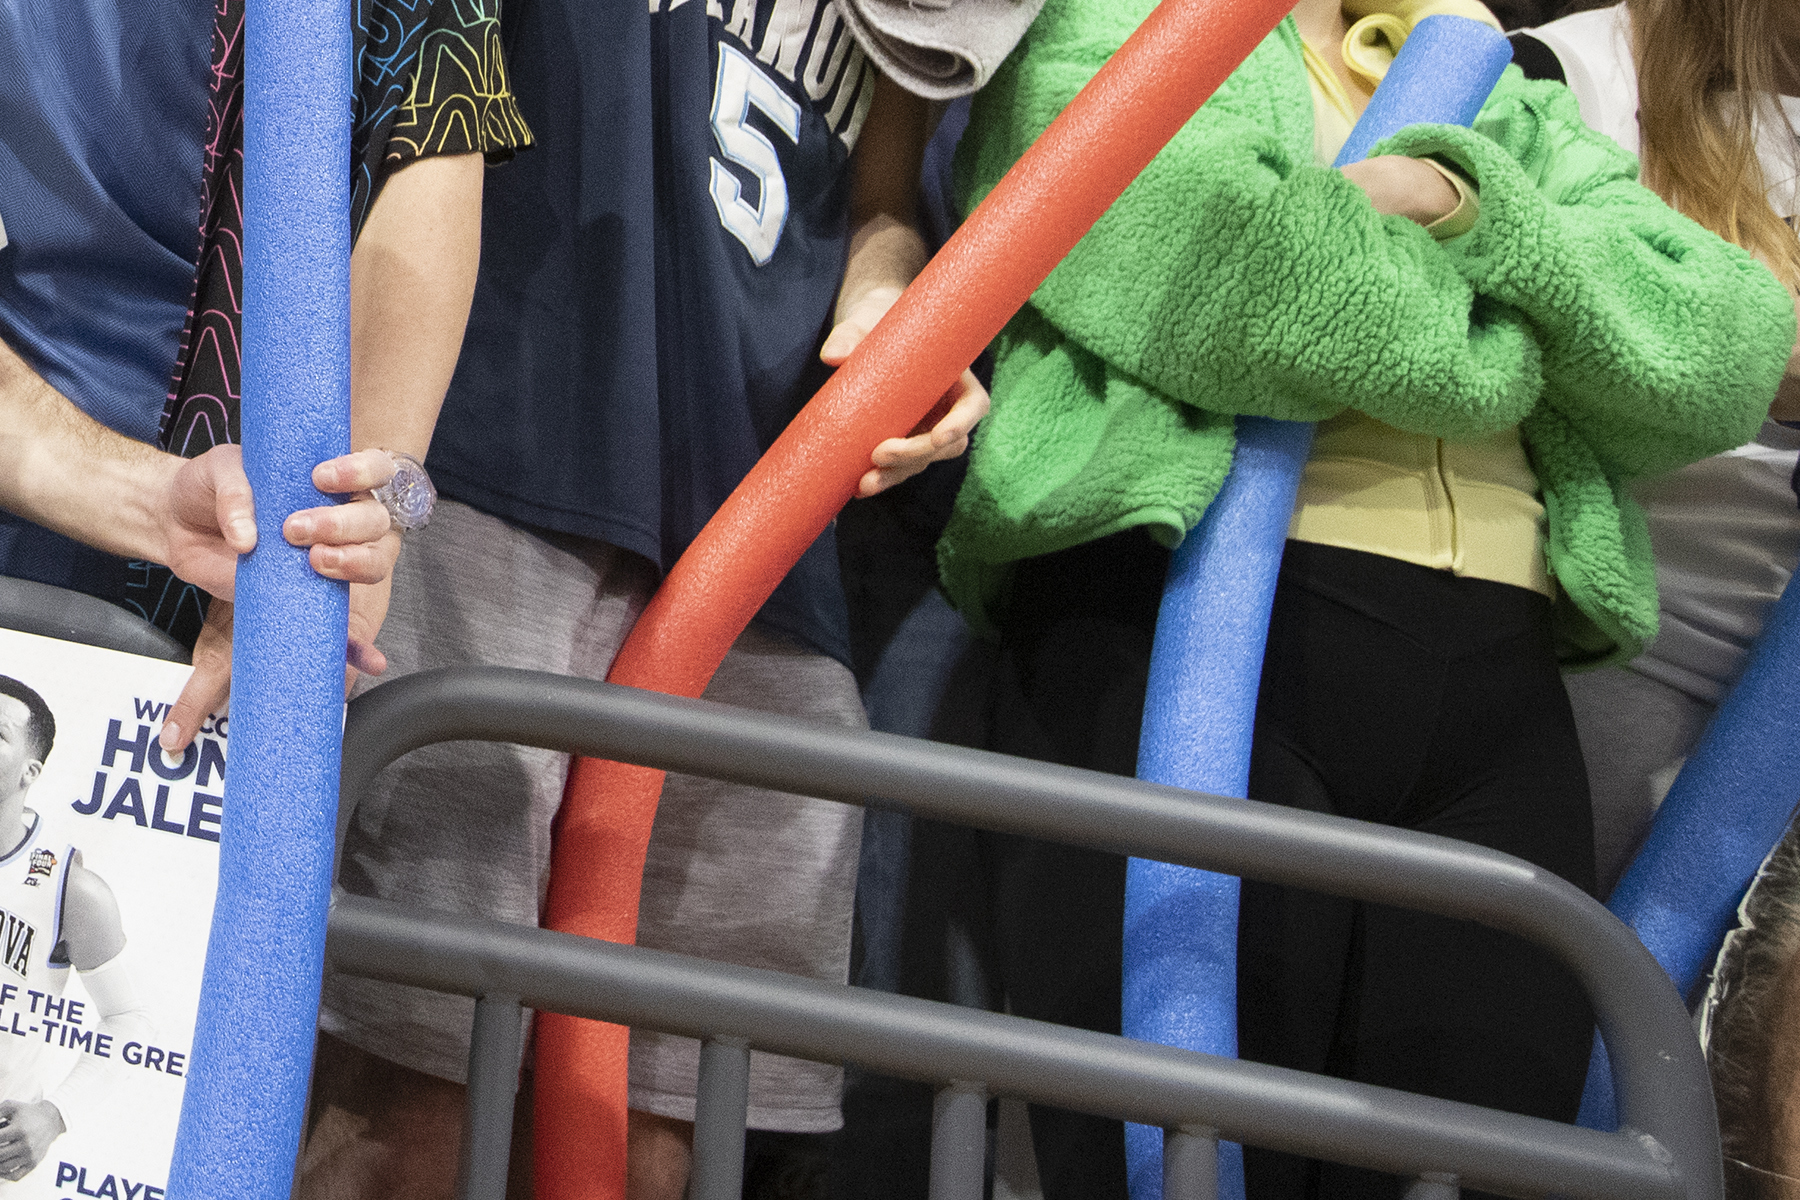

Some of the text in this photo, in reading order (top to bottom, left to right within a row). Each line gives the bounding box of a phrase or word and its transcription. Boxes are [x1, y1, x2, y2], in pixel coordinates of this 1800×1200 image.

[708, 40, 802, 268] 5
[27, 990, 85, 1025] THE
[122, 1041, 187, 1078] GRE
